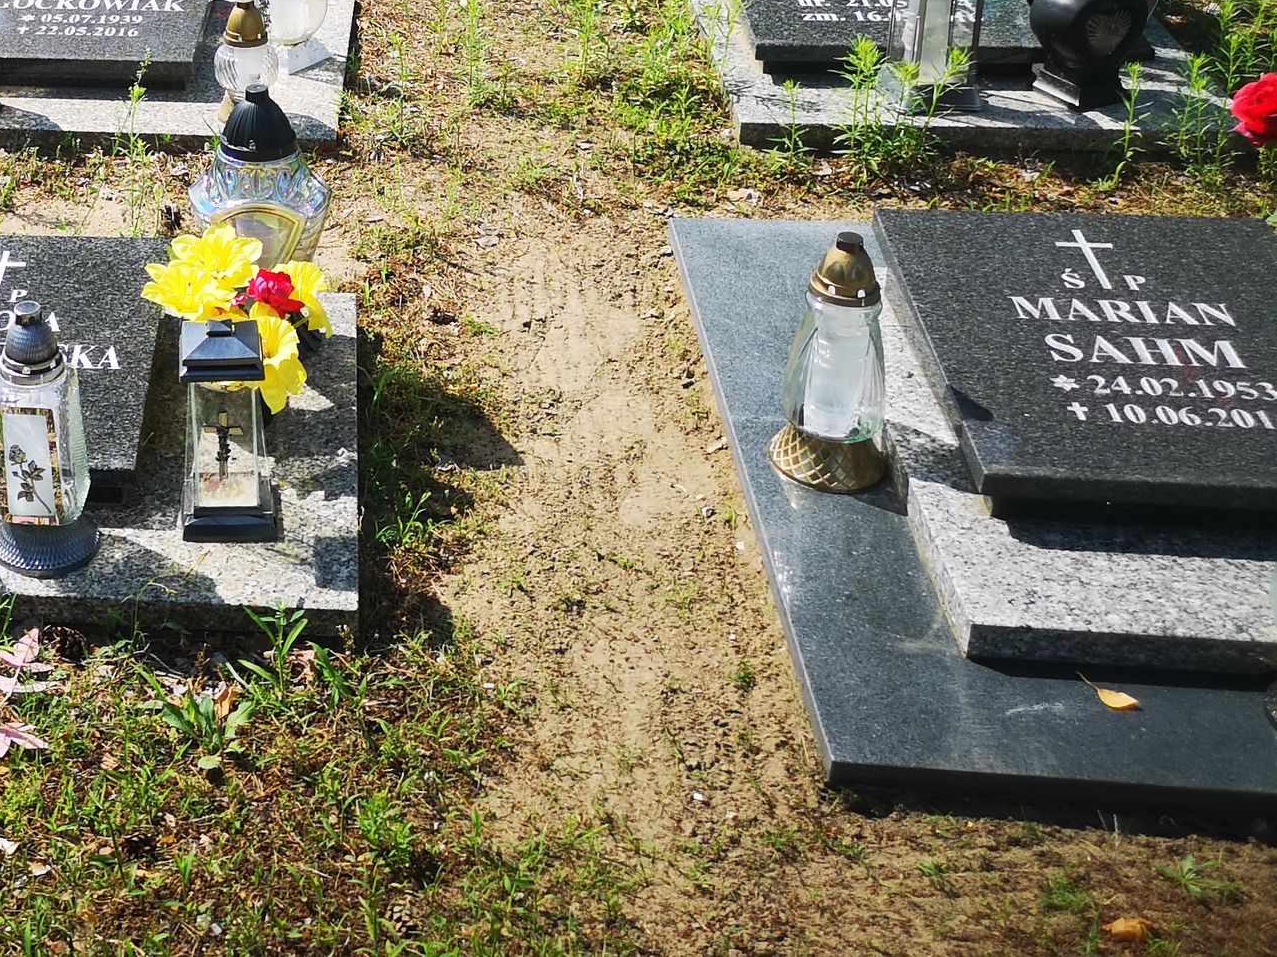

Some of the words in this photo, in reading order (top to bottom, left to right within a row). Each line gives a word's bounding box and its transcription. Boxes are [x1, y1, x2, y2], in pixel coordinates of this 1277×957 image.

[40, 13, 144, 24] 05.07.1939
[801, 12, 845, 22] zm.
[34, 25, 140, 37] 22.05.2016
[1060, 268, 1085, 290] Ś
[1123, 274, 1147, 291] P
[10, 289, 28, 303] P
[1006, 295, 1237, 328] MARIAN
[1044, 333, 1248, 369] SAHM
[1086, 374, 1277, 401] 24.02.1953
[1104, 402, 1277, 430] 10.06.201
